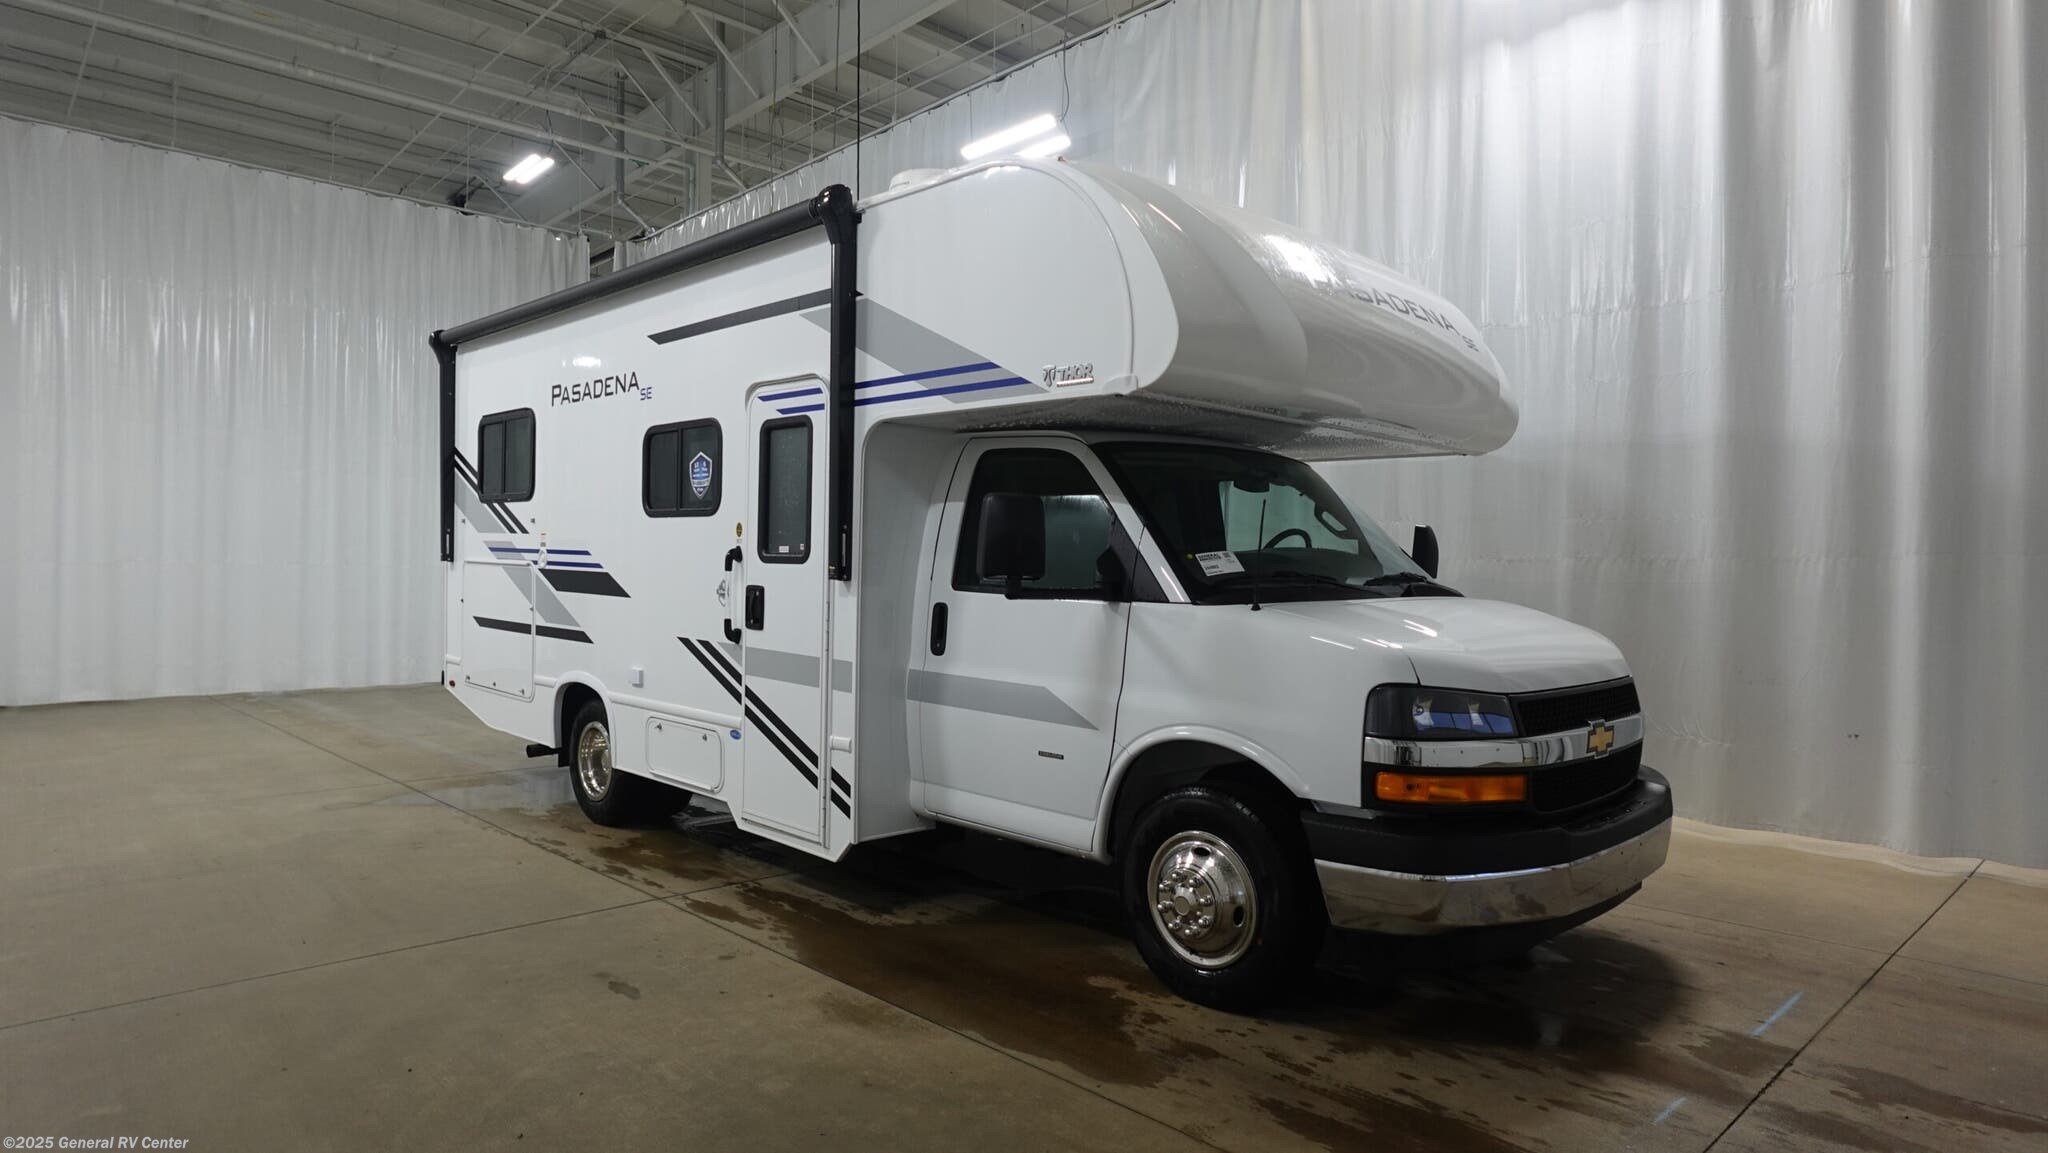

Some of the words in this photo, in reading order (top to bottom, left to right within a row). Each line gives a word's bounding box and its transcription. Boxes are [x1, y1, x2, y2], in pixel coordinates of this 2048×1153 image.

[1316, 278, 1460, 336] SADENA
[551, 371, 640, 407] PASADENA
[640, 386, 653, 401] SE
[1056, 363, 1094, 381] THOR
